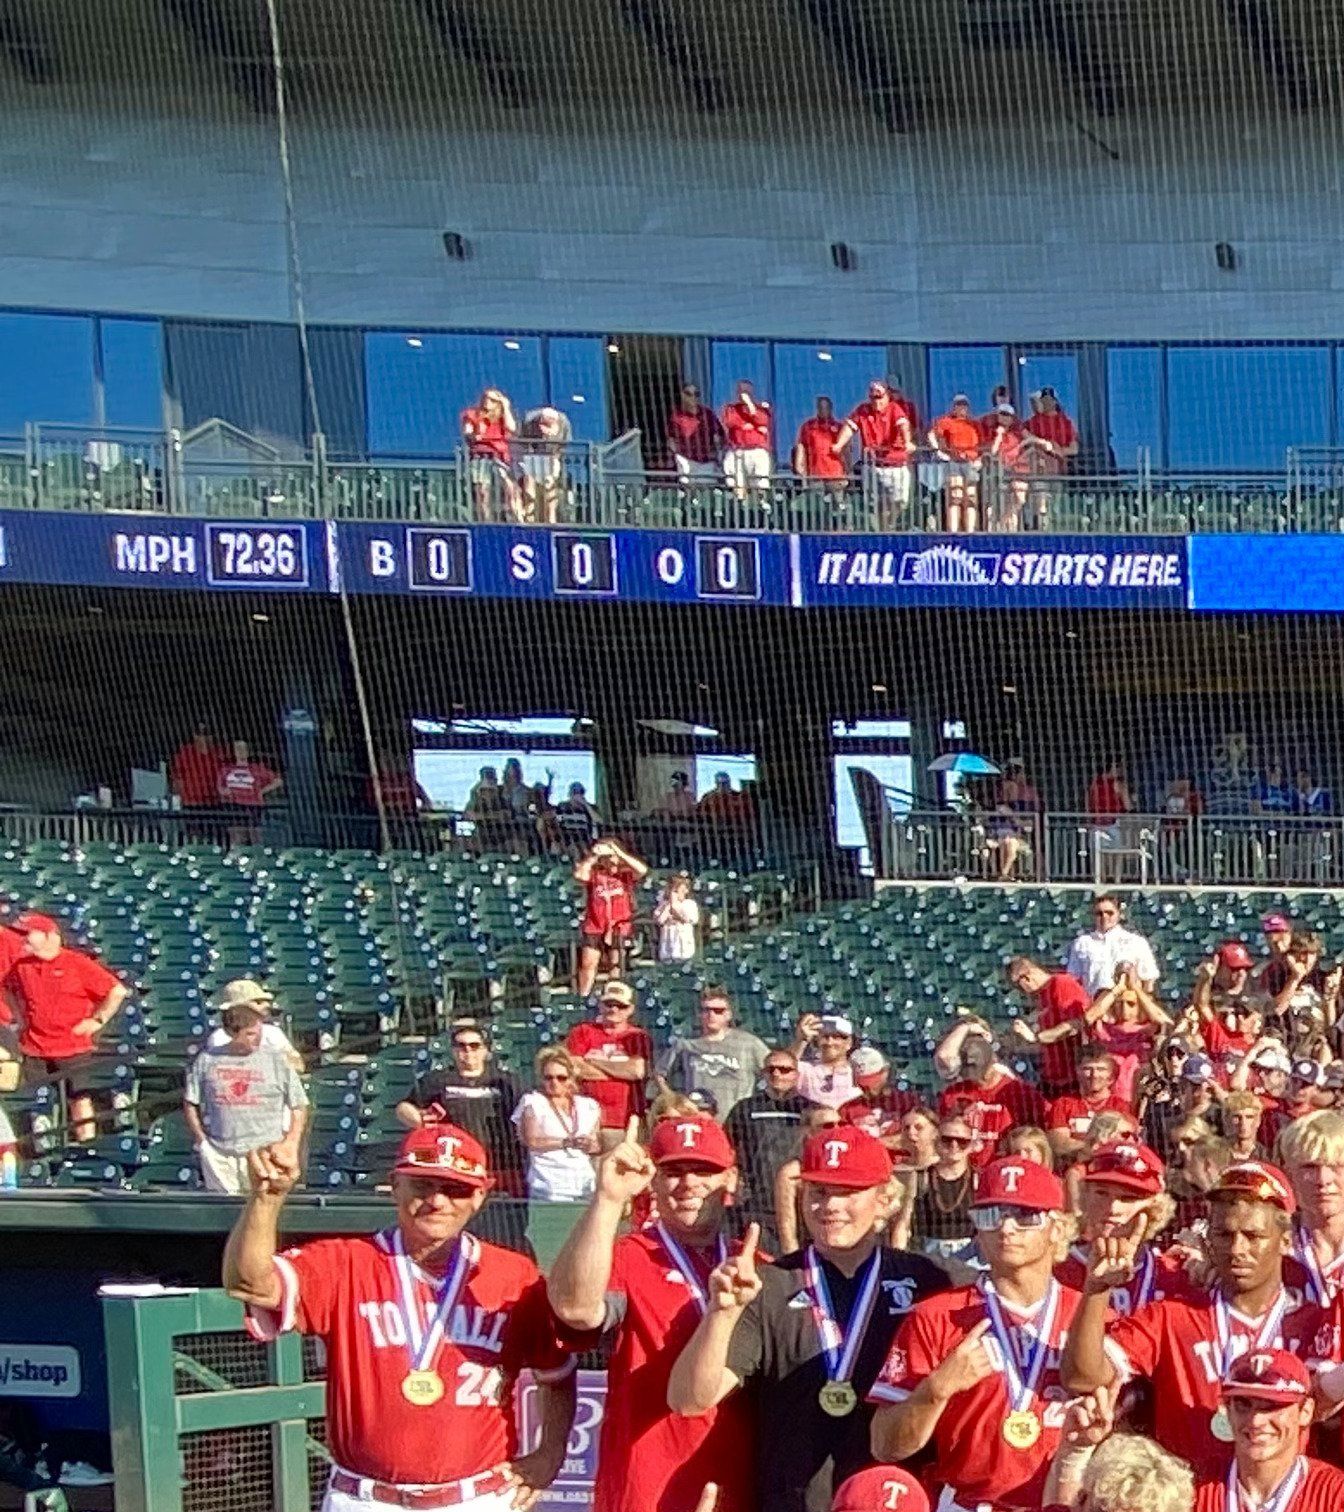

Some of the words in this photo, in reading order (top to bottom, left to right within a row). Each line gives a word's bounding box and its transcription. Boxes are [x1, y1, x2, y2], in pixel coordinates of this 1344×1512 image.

[115, 531, 198, 575] MPH
[219, 532, 296, 576] 72.36
[370, 539, 396, 577] B
[427, 538, 451, 582] 0
[510, 542, 536, 581] S
[570, 541, 594, 586] 0
[656, 547, 685, 585] O
[716, 546, 738, 590] 0
[817, 552, 849, 585] IT
[846, 551, 896, 585] ALL
[1000, 552, 1107, 587] STARTS
[676, 1122, 702, 1148] T
[824, 1139, 849, 1167] T
[1000, 1166, 1025, 1192] T
[0, 1356, 69, 1387] /shop
[884, 1480, 909, 1510] T
